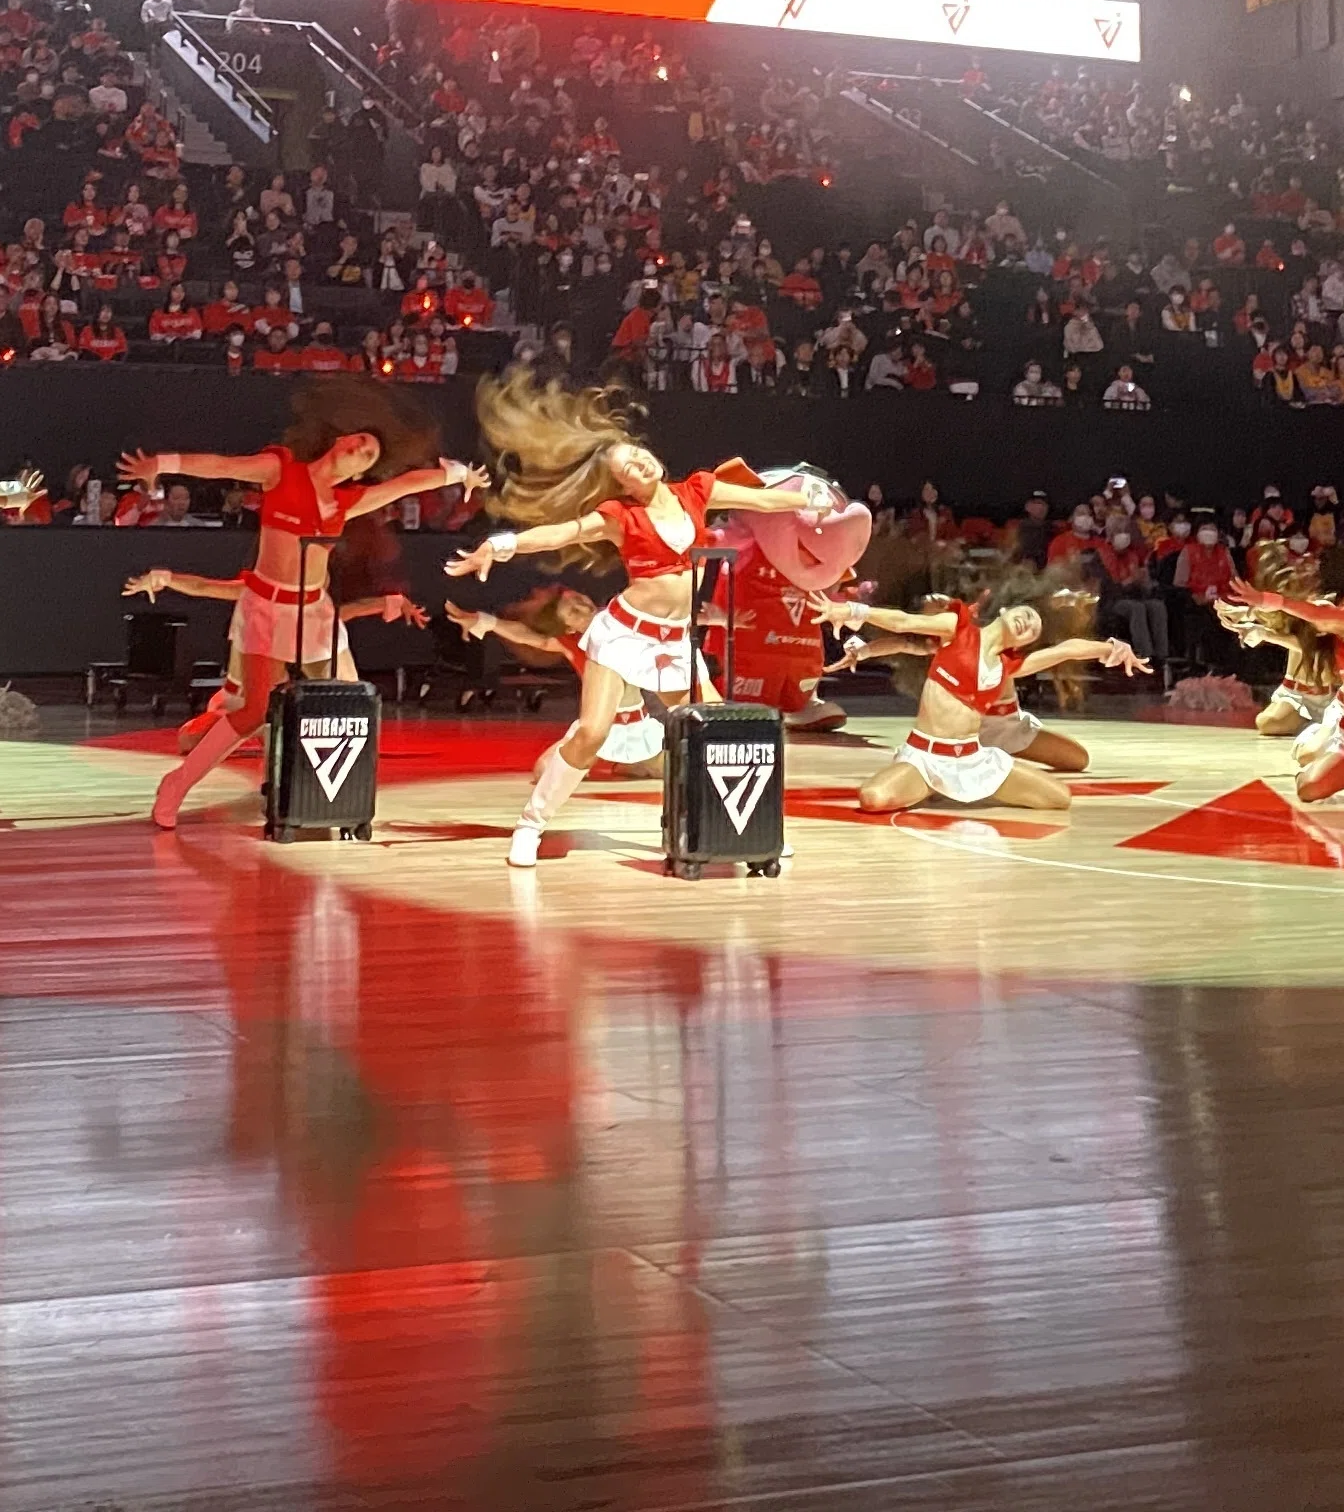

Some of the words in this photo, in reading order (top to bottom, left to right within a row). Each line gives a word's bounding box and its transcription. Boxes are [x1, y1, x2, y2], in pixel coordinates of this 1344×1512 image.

[217, 51, 263, 75] 204
[300, 717, 369, 737] CHIBAJETS
[706, 743, 775, 764] CHIBAJETS
